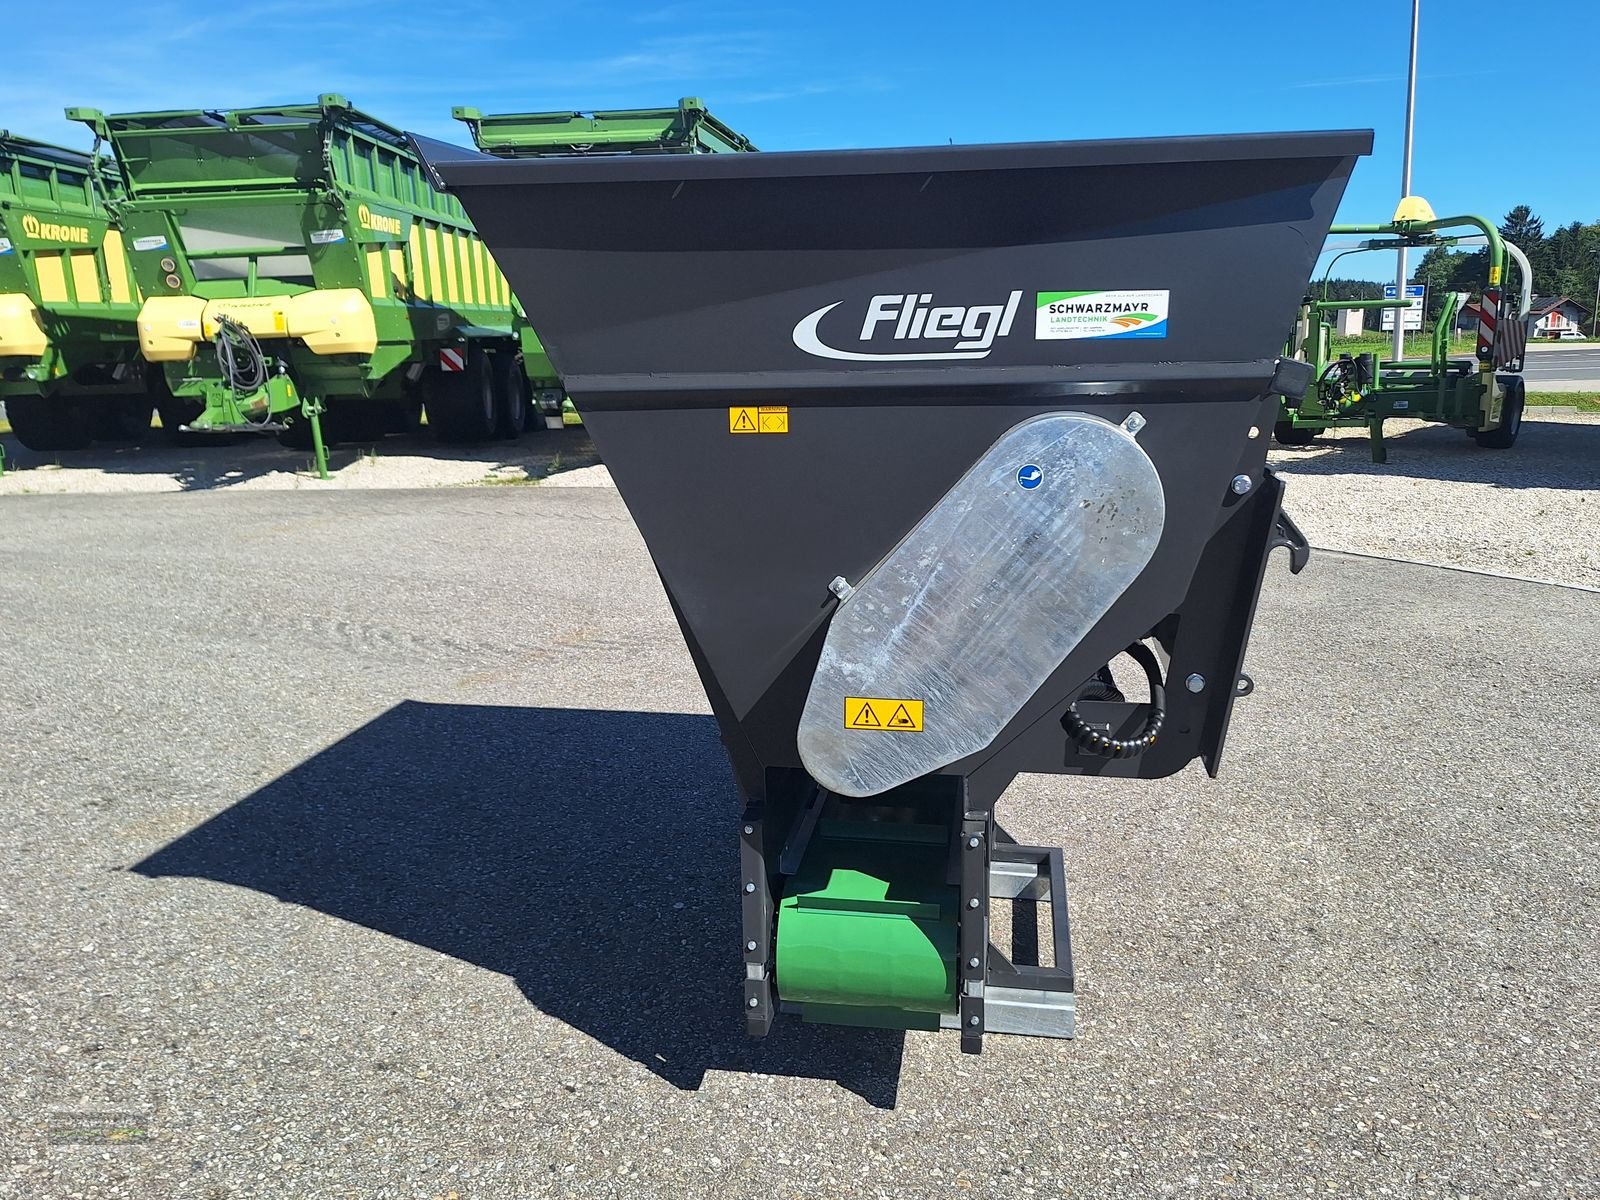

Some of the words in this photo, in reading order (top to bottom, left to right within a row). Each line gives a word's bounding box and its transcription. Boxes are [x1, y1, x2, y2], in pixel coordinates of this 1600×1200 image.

[40, 223, 89, 244] KRONE
[370, 213, 401, 235] KRONE
[1049, 303, 1149, 313] SCHWARZMAYR
[859, 290, 1024, 350] Fliegl
